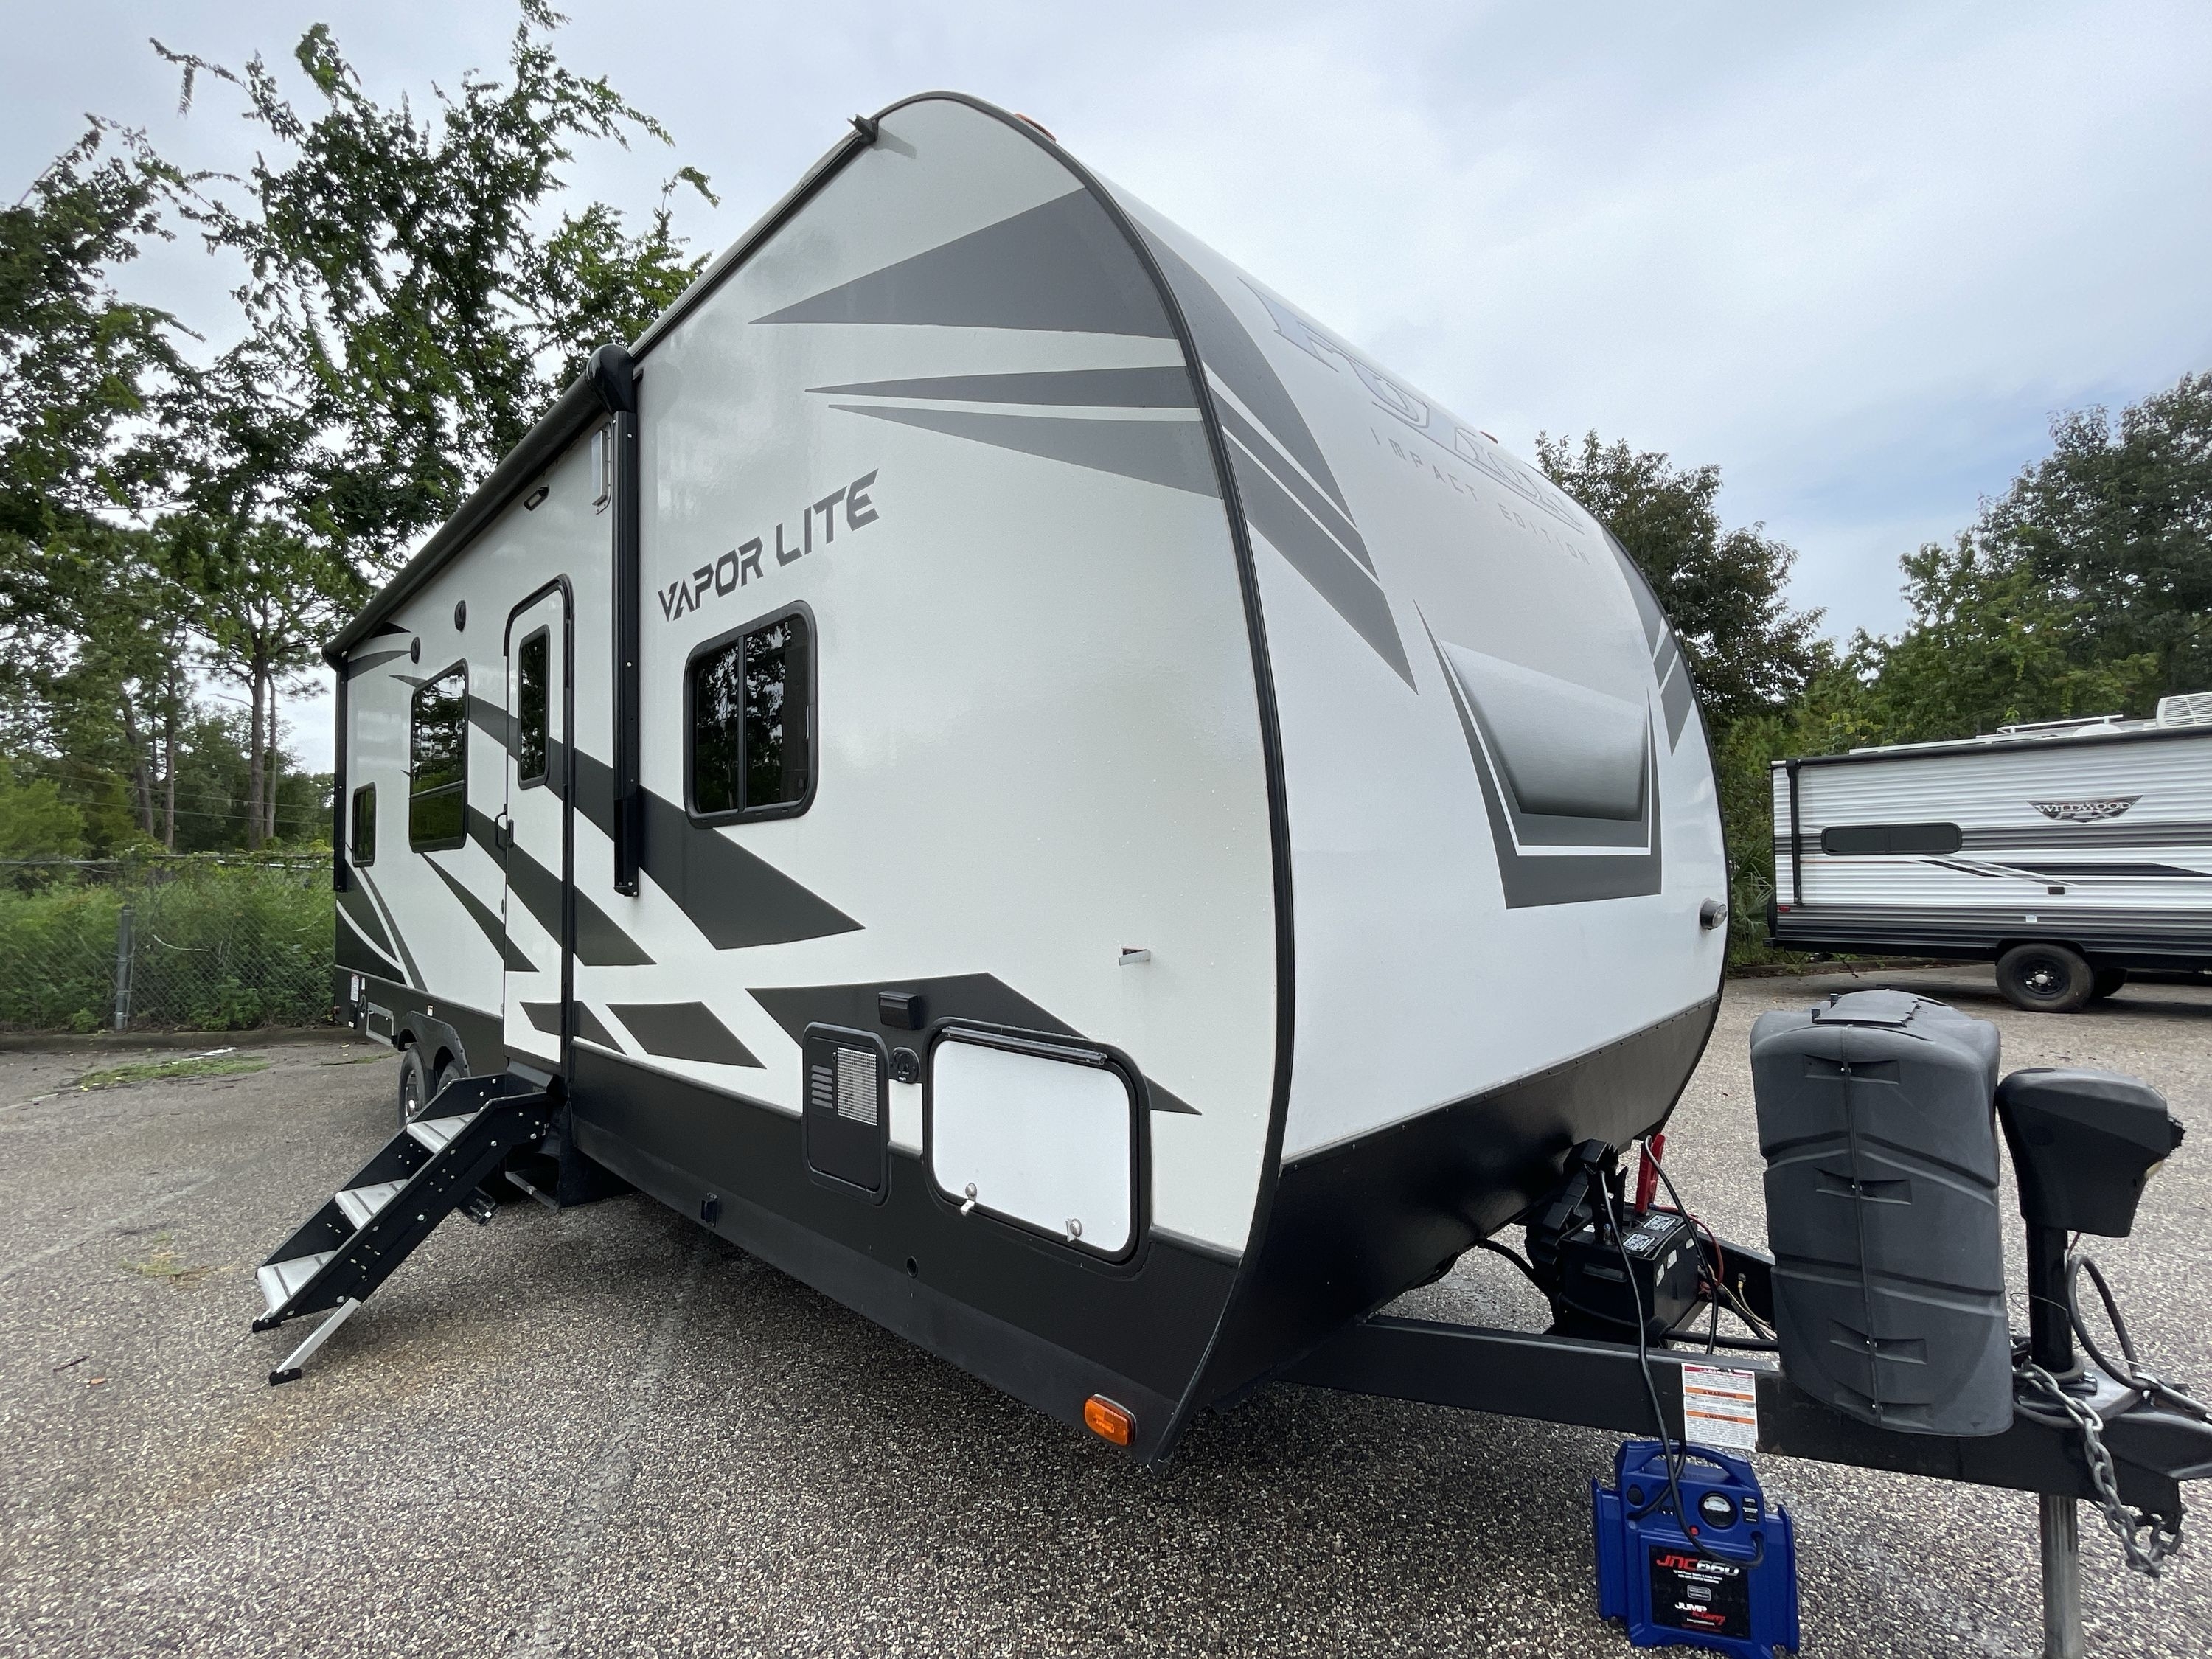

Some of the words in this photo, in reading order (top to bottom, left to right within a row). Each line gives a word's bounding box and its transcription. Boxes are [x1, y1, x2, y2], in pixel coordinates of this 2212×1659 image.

[658, 536, 764, 622] VAPOR
[776, 468, 880, 567] LITE
[1370, 427, 1478, 501] IMPACT
[1498, 503, 1591, 565] EDITION
[2034, 801, 2132, 813] WILDWOOD
